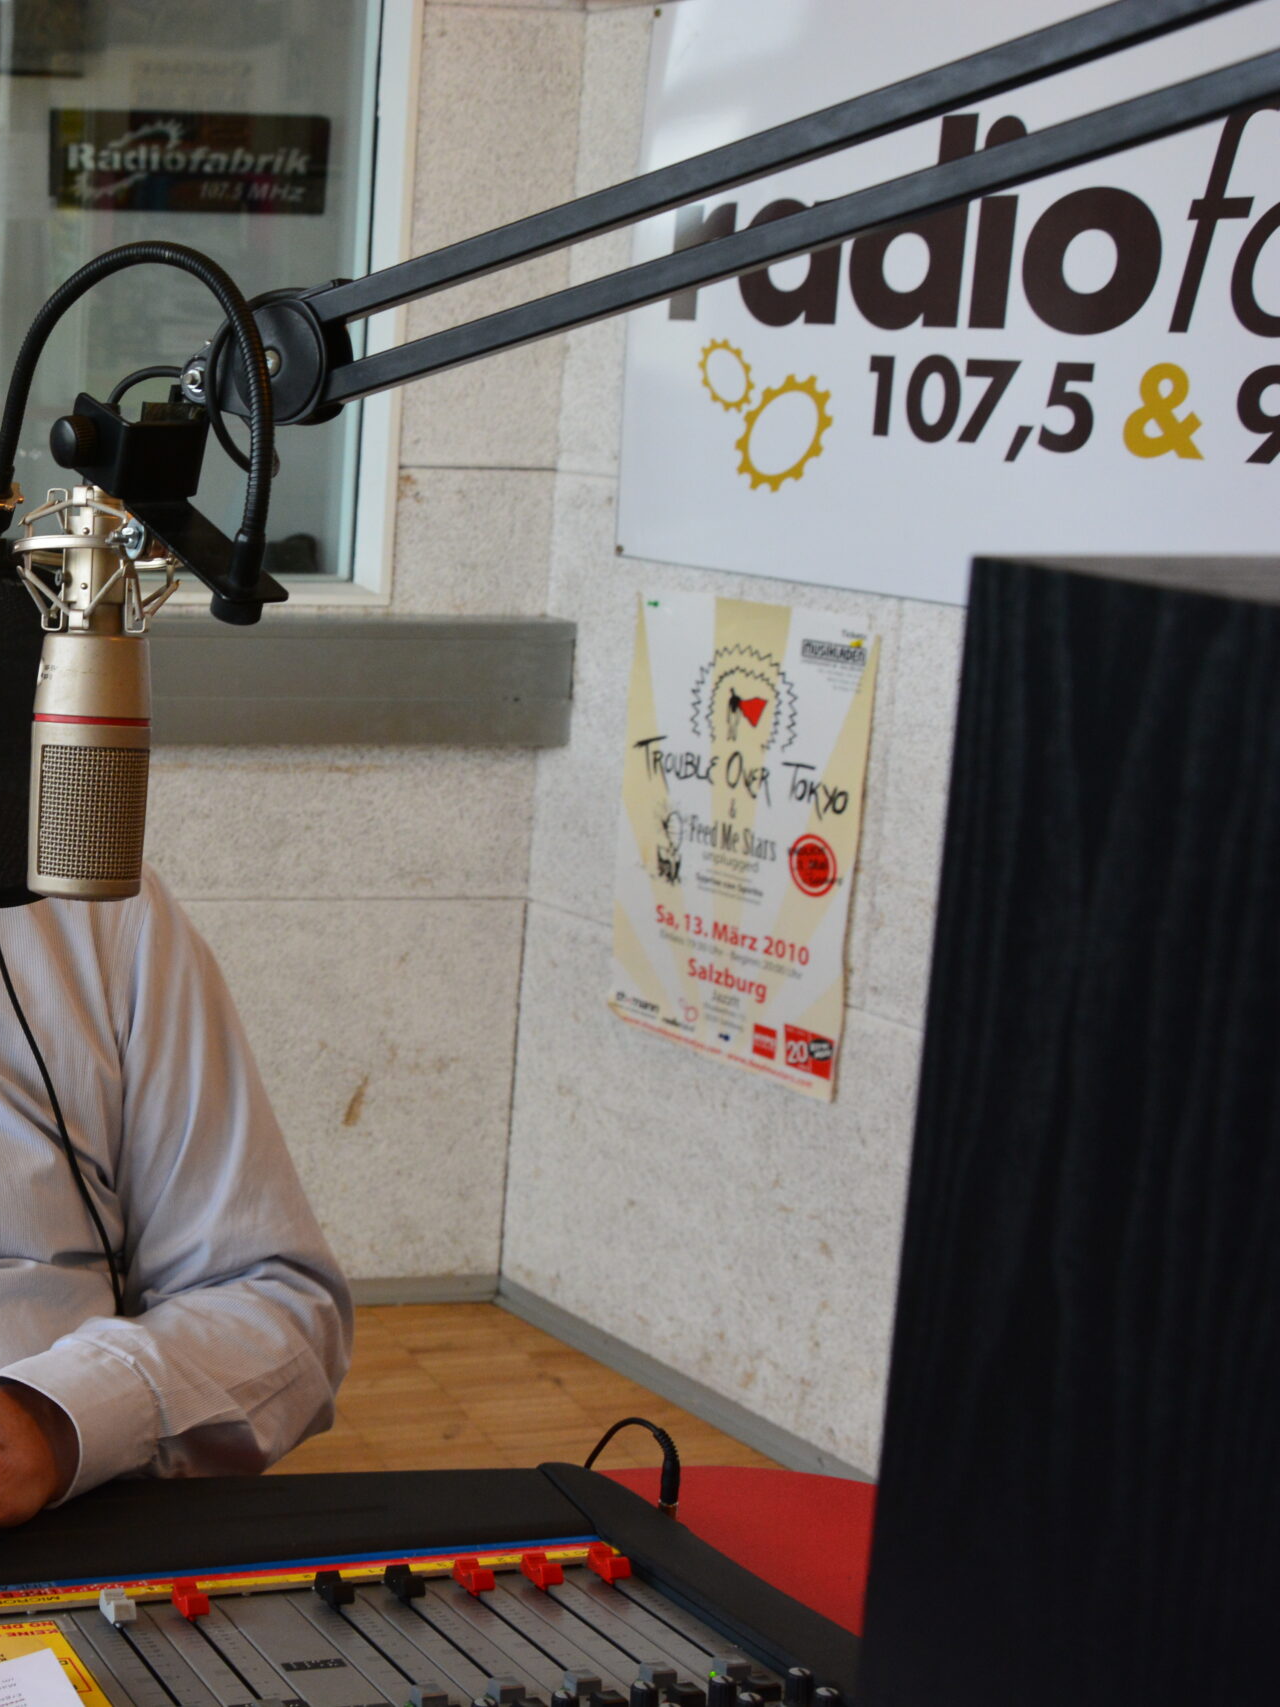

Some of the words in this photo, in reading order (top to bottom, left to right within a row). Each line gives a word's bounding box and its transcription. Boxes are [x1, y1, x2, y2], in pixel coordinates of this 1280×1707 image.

[67, 142, 310, 175] Radiofabrik
[247, 182, 307, 201] MHz
[869, 353, 1095, 462] 107,5
[1122, 362, 1205, 460] &
[782, 761, 849, 821] TOKYO
[687, 814, 719, 848] Feed
[721, 822, 740, 852] Me
[743, 828, 777, 862] Stars
[655, 904, 680, 930] Sa,
[684, 913, 709, 938] 13.
[711, 920, 758, 951] März
[763, 935, 810, 966] 2010
[687, 957, 768, 1004] Salzburg
[785, 1040, 809, 1065] 20
[6, 1629, 60, 1638] KEINE
[29, 1620, 54, 1628] NO
